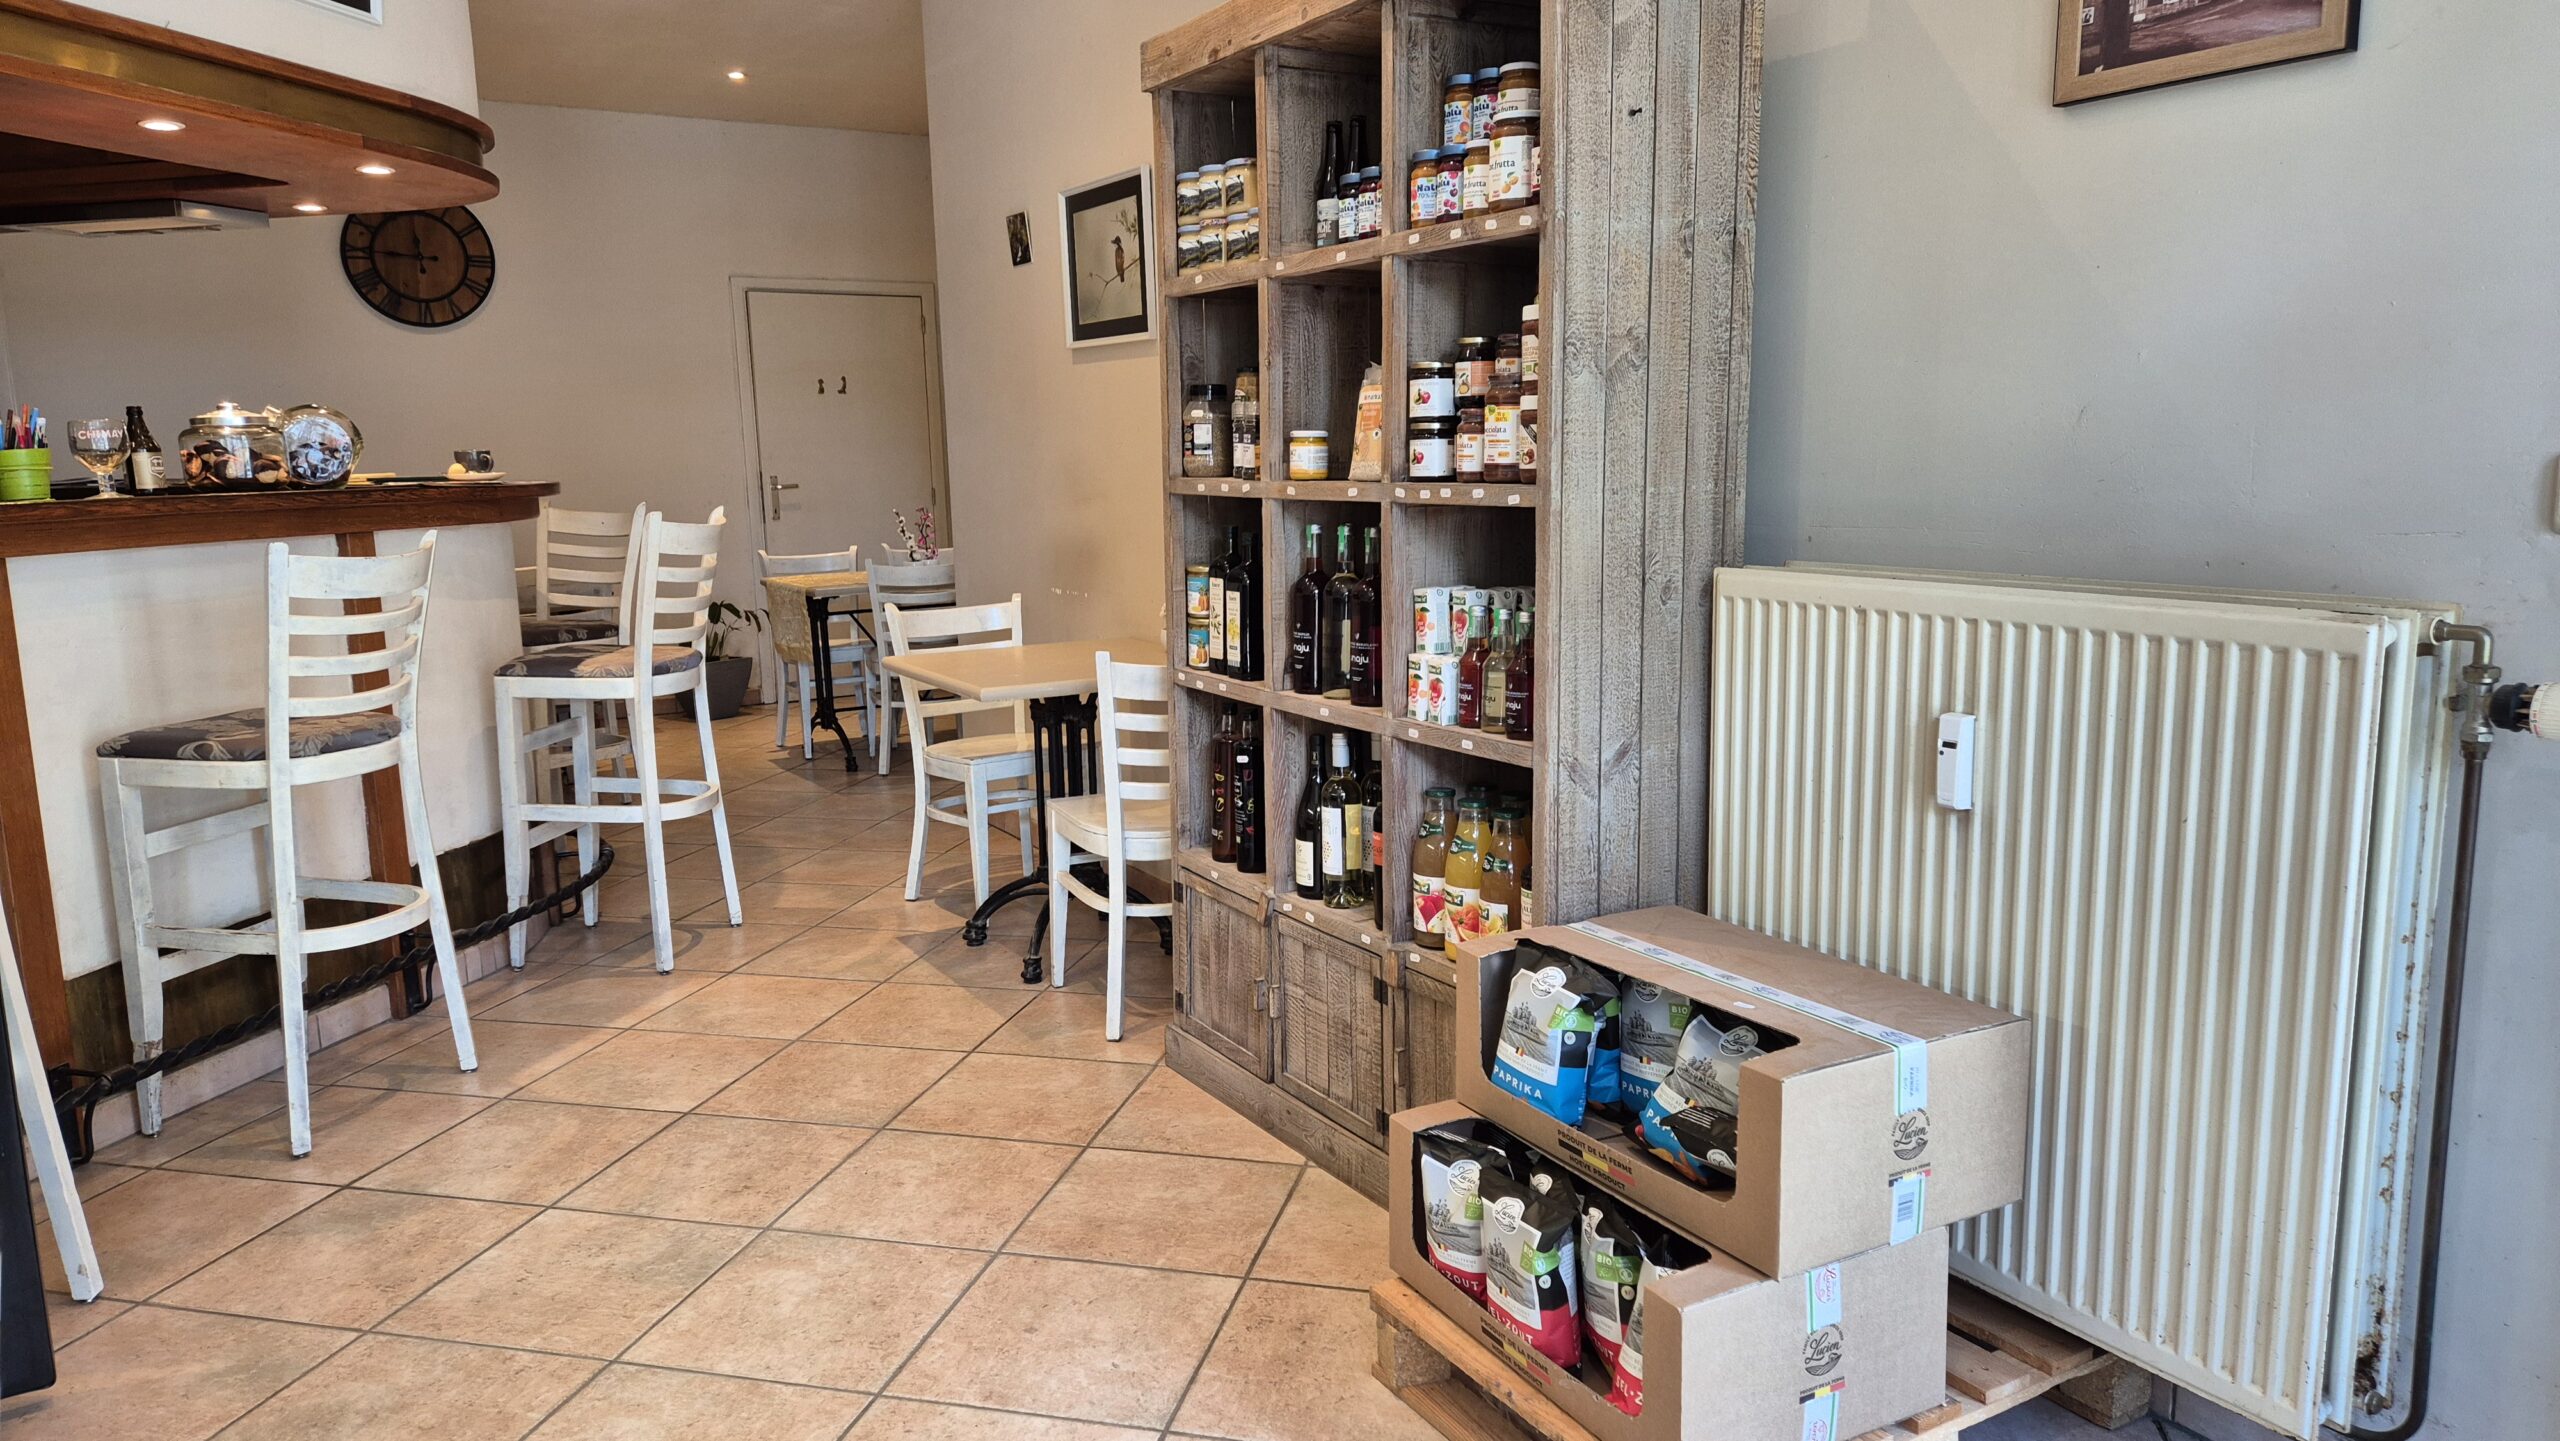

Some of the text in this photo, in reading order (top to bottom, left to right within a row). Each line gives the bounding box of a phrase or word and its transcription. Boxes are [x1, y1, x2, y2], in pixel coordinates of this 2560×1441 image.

[78, 429, 123, 440] CHIMAY
[1671, 1006, 1688, 1015] BIO
[1493, 1064, 1543, 1100] PAPRIKA
[1622, 1081, 1655, 1099] PAPRI
[1893, 1116, 1928, 1148] Lucien
[1557, 1129, 1633, 1175] PRODUIT DE LA FERME
[1593, 1167, 1626, 1191] PRODUCT
[1597, 1254, 1612, 1266] BIO
[1805, 1332, 1841, 1364] Lucien
[1800, 1385, 1817, 1395] PRODUIT
